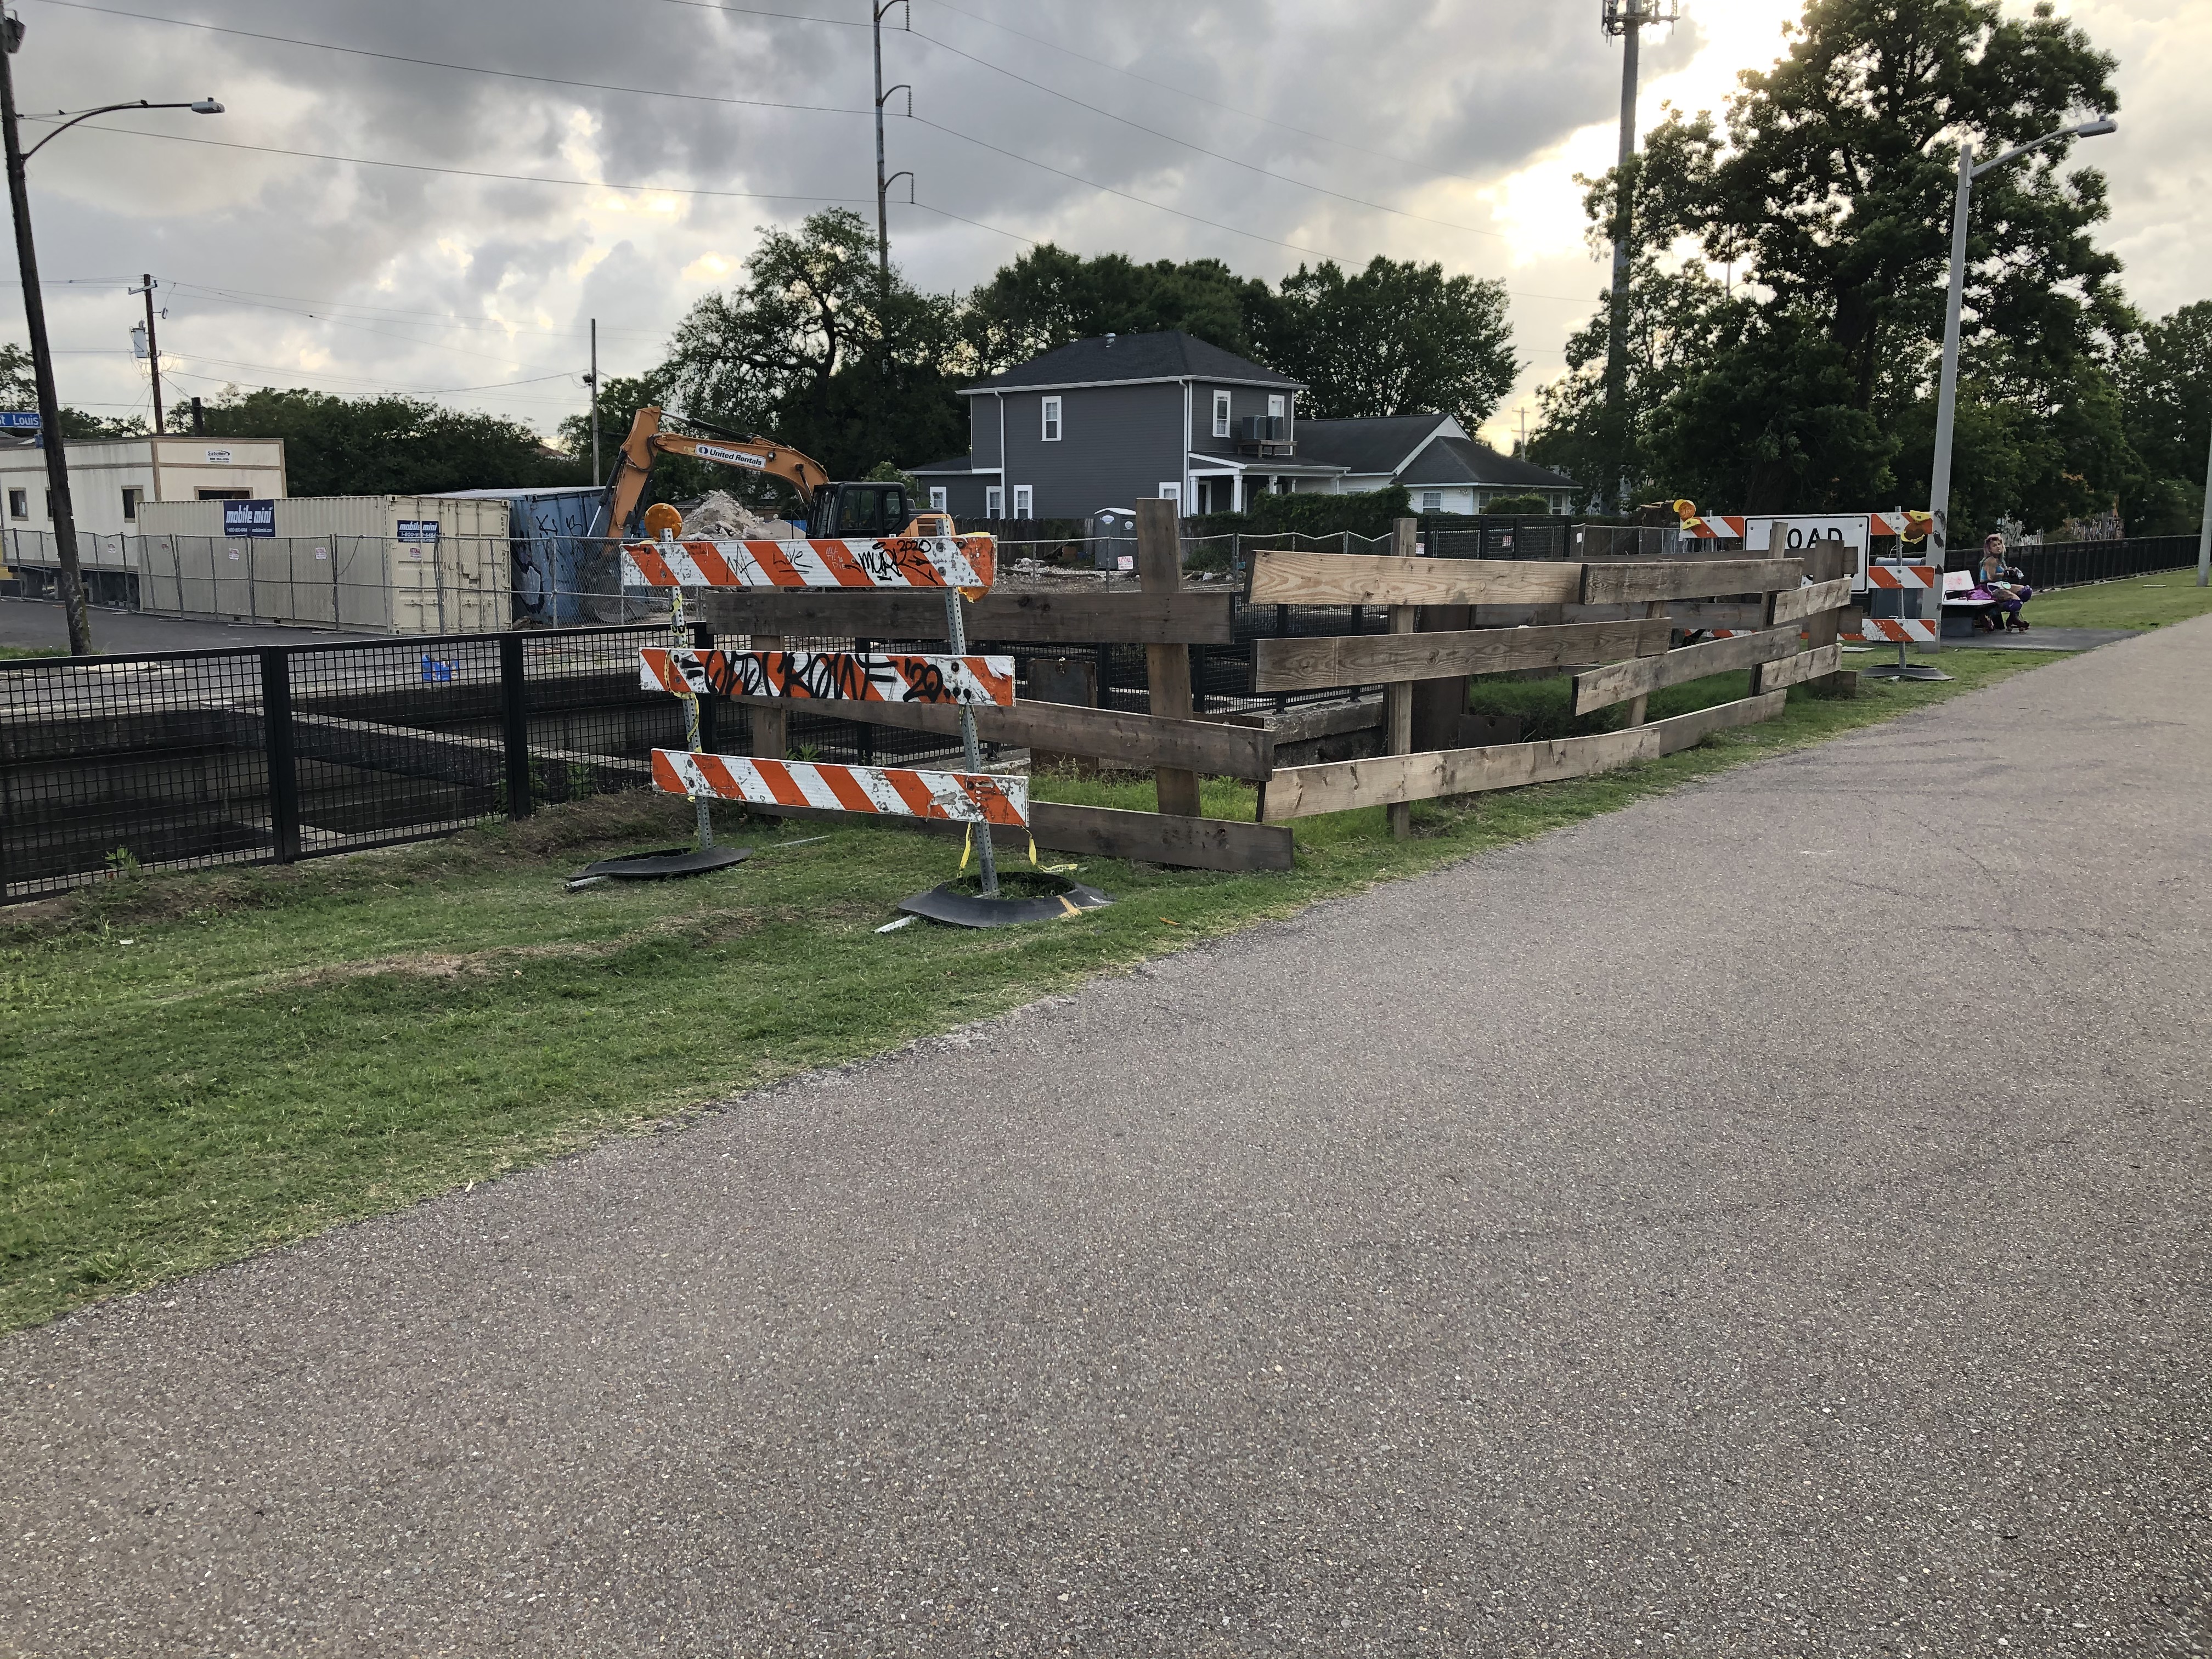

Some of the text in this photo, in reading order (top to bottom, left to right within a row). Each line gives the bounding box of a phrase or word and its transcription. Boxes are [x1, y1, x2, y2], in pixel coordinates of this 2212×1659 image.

[0, 415, 39, 425] t Louis
[709, 449, 762, 466] United Rentals
[225, 504, 272, 523] mobile mini
[422, 523, 438, 531] mini
[897, 539, 932, 553] 2020
[1770, 528, 1843, 549] OAD
